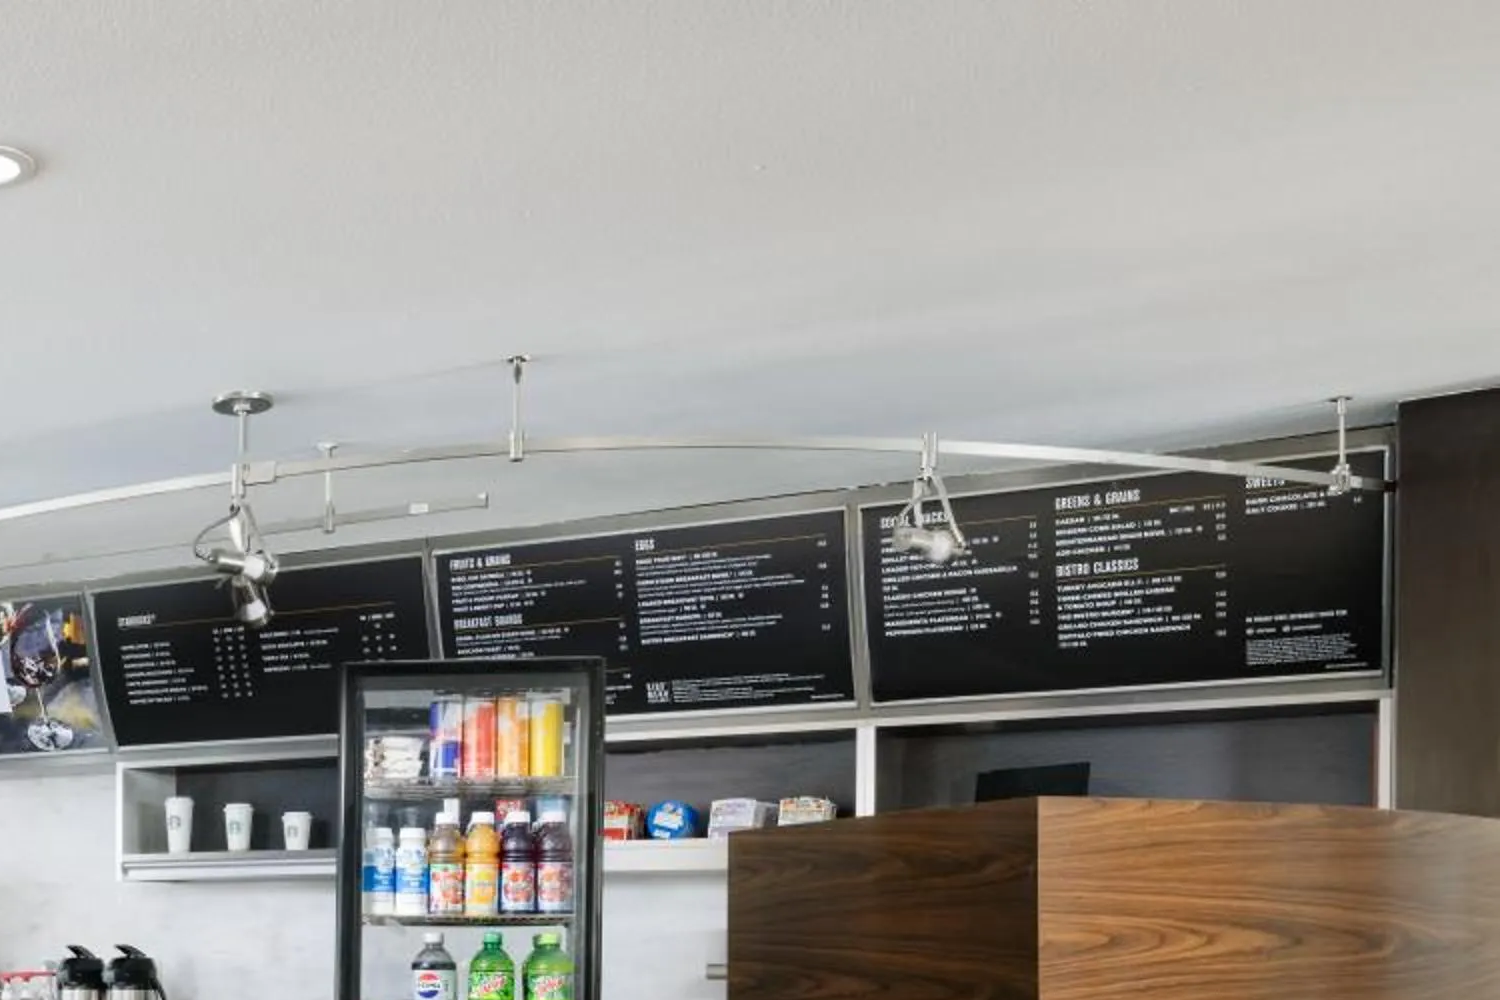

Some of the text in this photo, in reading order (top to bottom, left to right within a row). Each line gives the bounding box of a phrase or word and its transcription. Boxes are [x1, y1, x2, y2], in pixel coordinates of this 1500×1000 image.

[1055, 494, 1091, 510] GREENS
[1105, 488, 1141, 505] GRAINS
[1055, 557, 1140, 577] BISTRO CLASSICS
